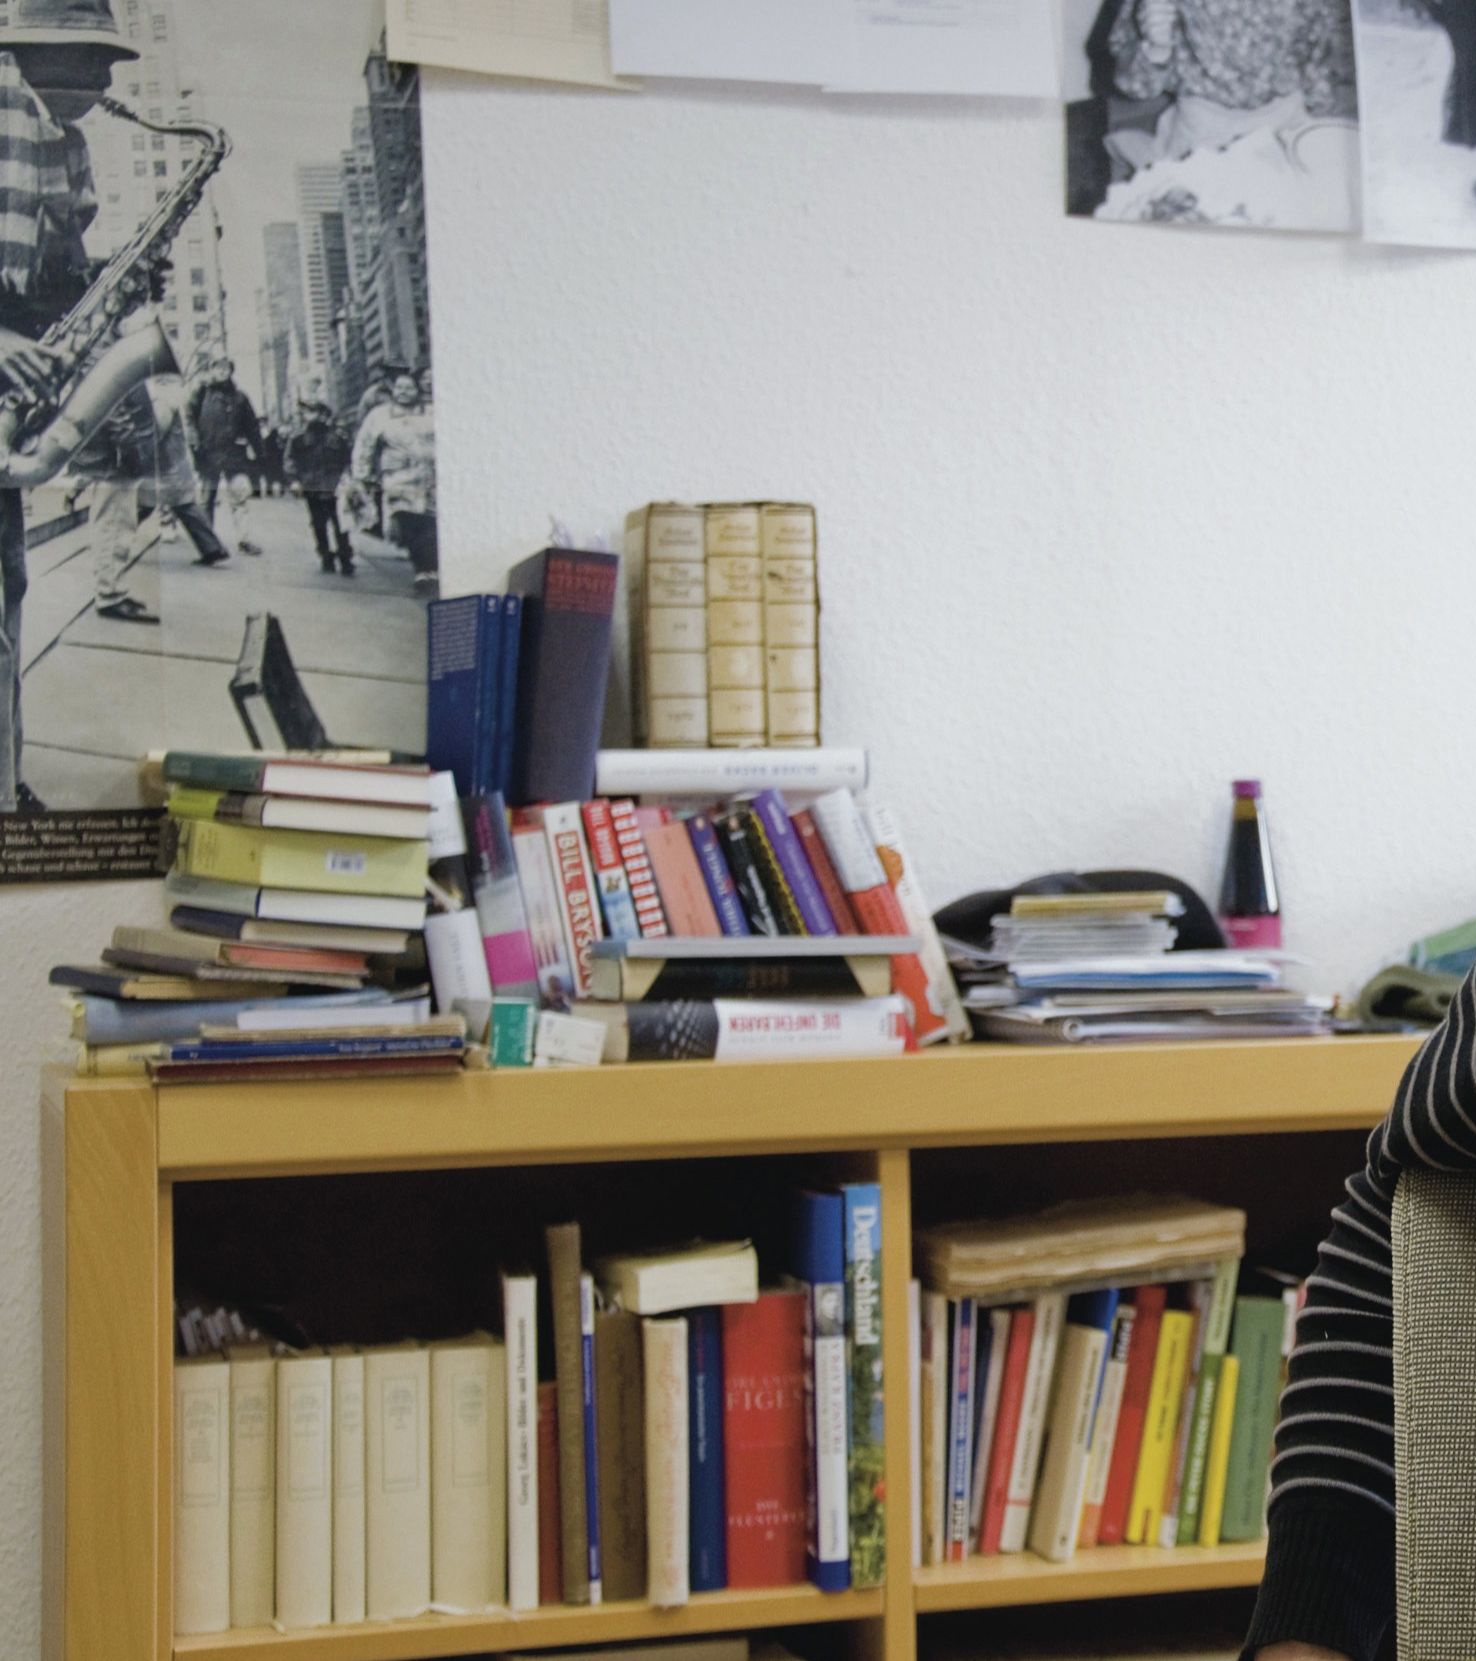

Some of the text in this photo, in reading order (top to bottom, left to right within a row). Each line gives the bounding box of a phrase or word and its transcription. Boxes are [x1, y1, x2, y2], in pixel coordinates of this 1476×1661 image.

[557, 834, 585, 883] BILL
[728, 1014, 817, 1032] UNFEHLBAREN
[852, 1205, 879, 1346] Deutschland
[951, 1498, 966, 1542] PIPER
